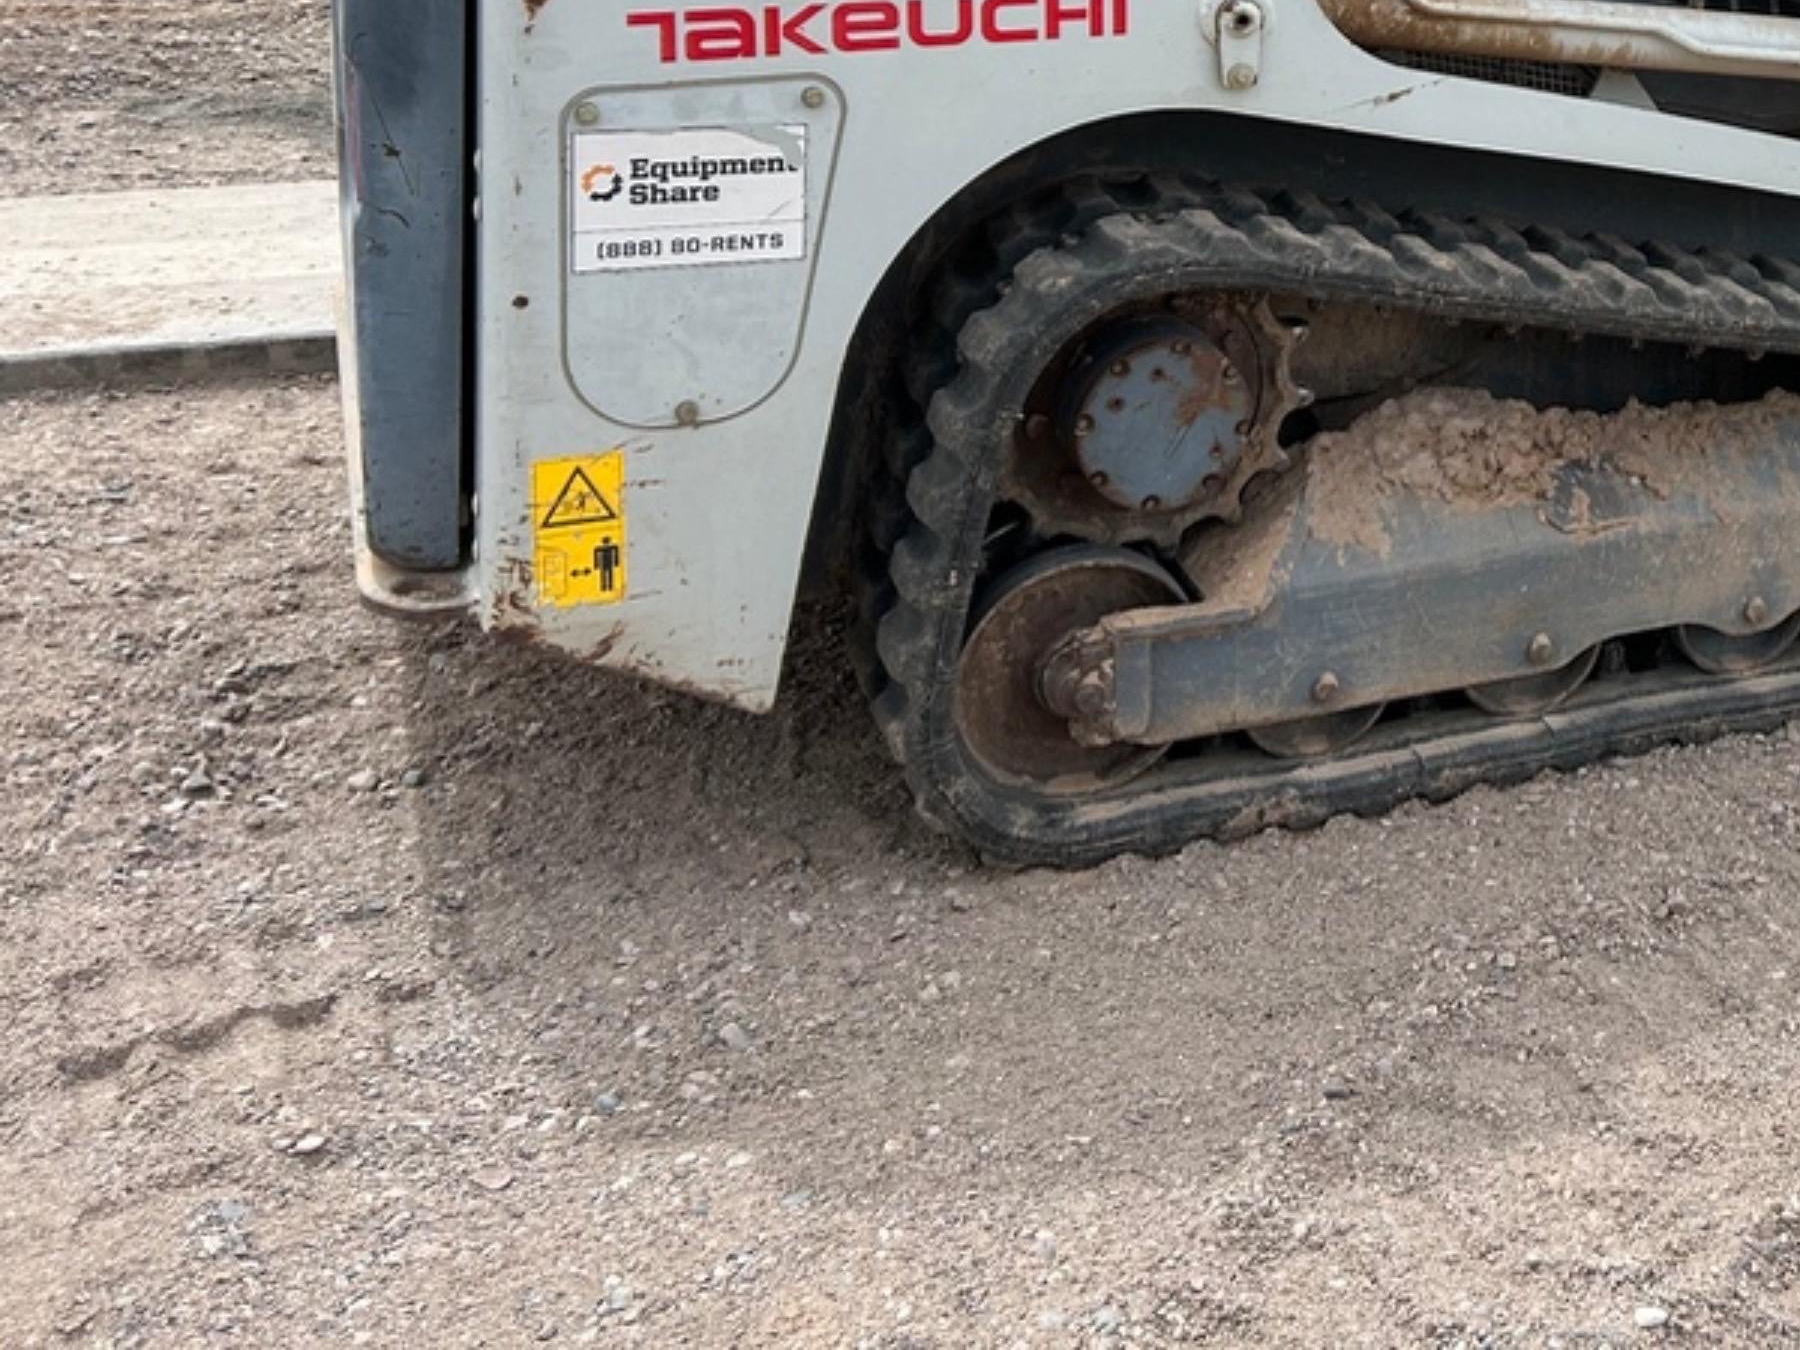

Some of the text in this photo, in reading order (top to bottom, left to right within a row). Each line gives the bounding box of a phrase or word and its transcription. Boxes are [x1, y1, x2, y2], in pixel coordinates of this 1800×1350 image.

[629, 155, 799, 183] Equipmen
[629, 183, 720, 205] Share
[596, 232, 785, 260] (888) 80-RENTS
